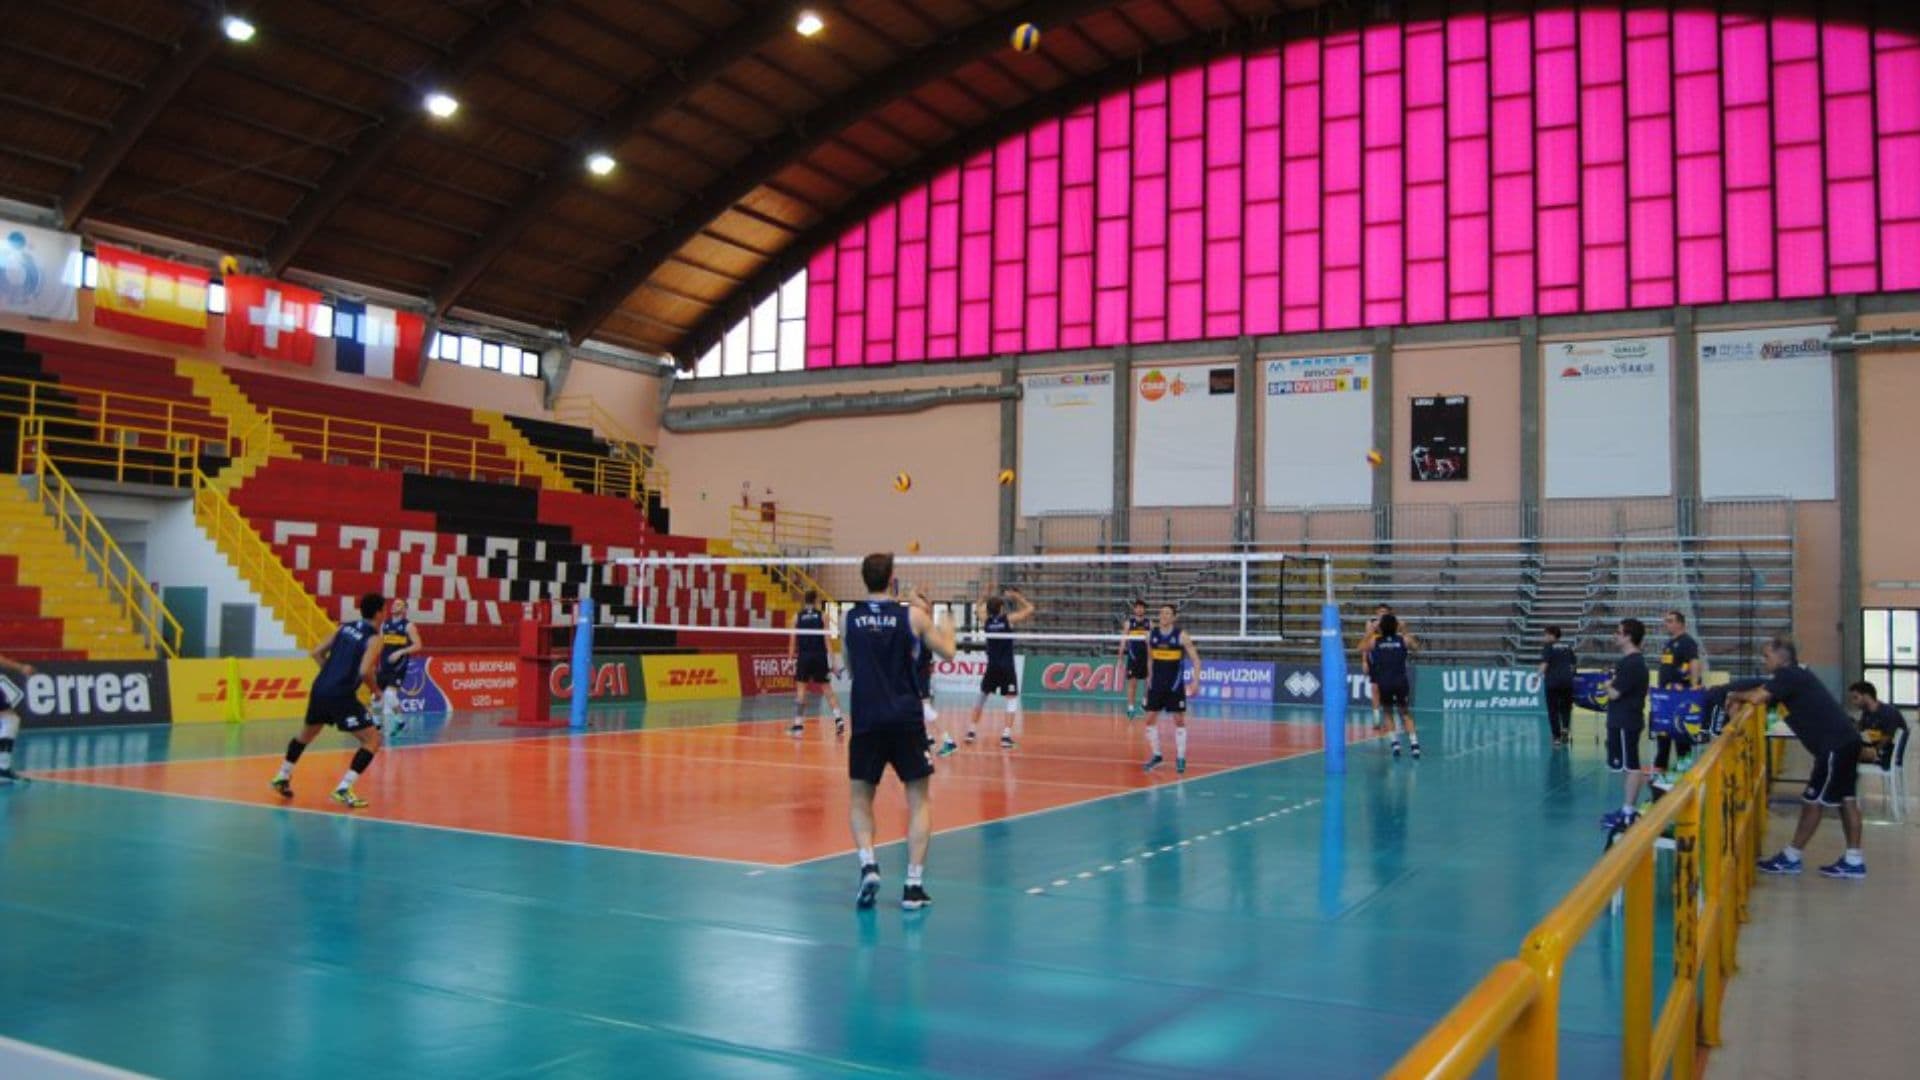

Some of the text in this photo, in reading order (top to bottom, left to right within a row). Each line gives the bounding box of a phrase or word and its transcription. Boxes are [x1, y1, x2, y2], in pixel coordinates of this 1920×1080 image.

[855, 616, 897, 628] ITALIA
[469, 661, 517, 673] EUROPEAN
[753, 658, 780, 677] FAIR
[452, 677, 518, 690] CHAMPIONSHIP
[668, 668, 719, 686] DHL
[1042, 662, 1126, 692] CRAI
[1442, 669, 1542, 694] ULIVETO
[401, 698, 425, 712] CEV
[1443, 698, 1473, 709] VIVI
[1490, 696, 1540, 708] FORMA
